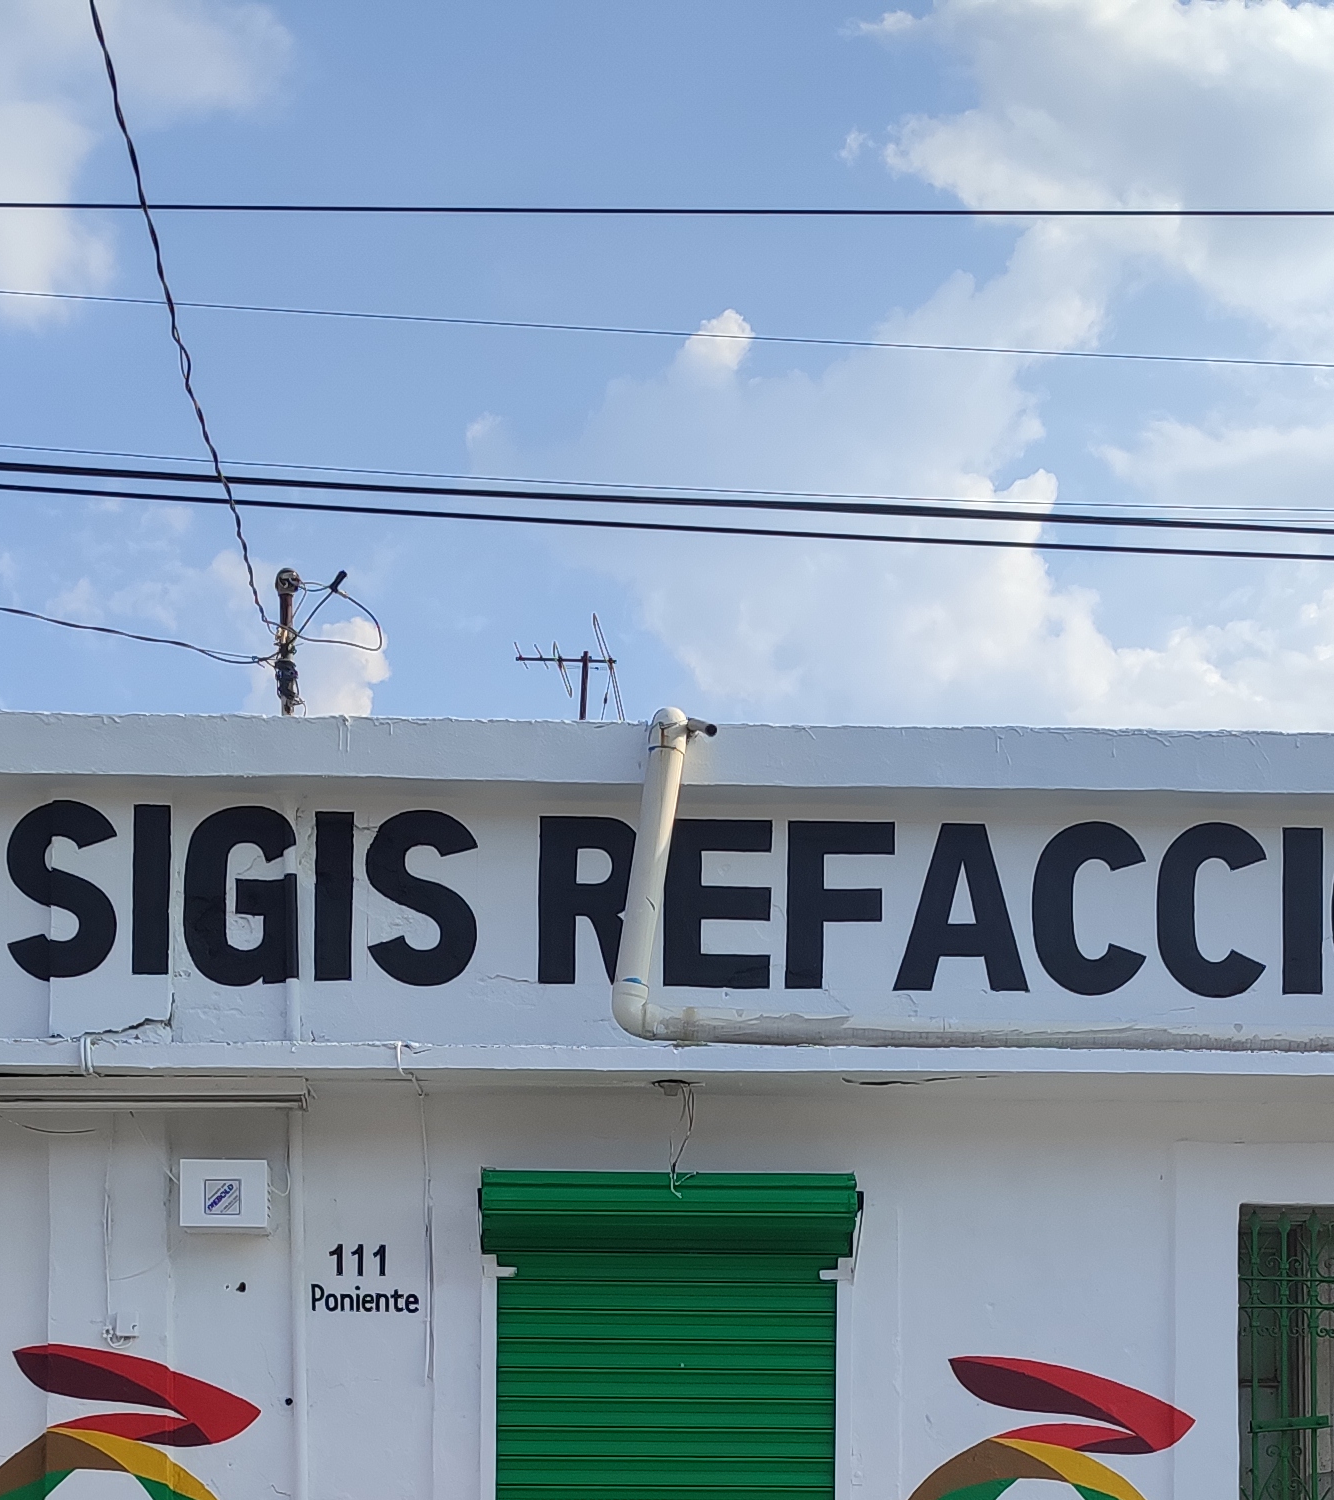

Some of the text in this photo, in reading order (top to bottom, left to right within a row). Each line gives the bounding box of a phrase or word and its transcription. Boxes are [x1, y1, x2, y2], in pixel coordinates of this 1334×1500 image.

[6, 799, 478, 987] SIGIS
[328, 1243, 387, 1277] 111
[310, 1283, 420, 1314] Poniente
